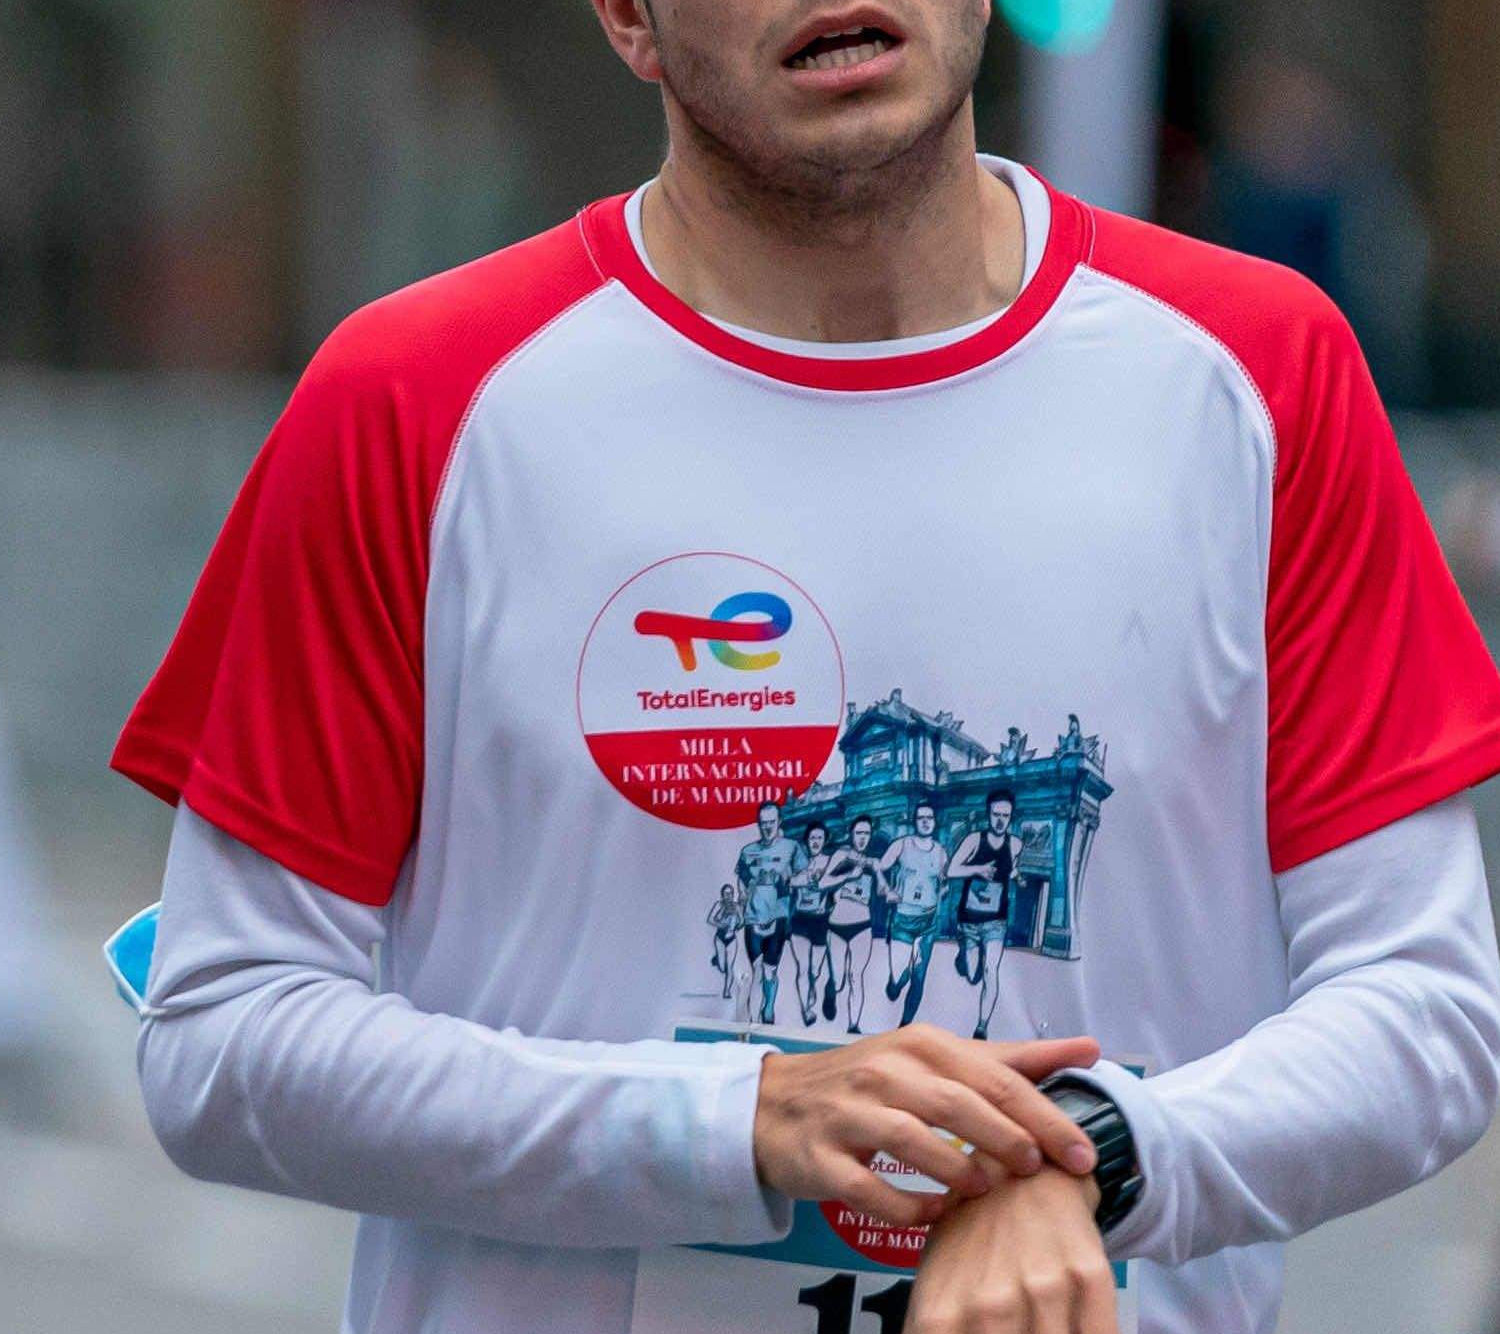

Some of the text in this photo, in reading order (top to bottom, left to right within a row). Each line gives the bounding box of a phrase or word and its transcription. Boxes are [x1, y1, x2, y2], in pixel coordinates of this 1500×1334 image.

[637, 686, 796, 712] TotalEnergies
[679, 736, 752, 757] MILLA
[651, 785, 781, 805] DE MADRID
[858, 1230, 926, 1251] DE MAD
